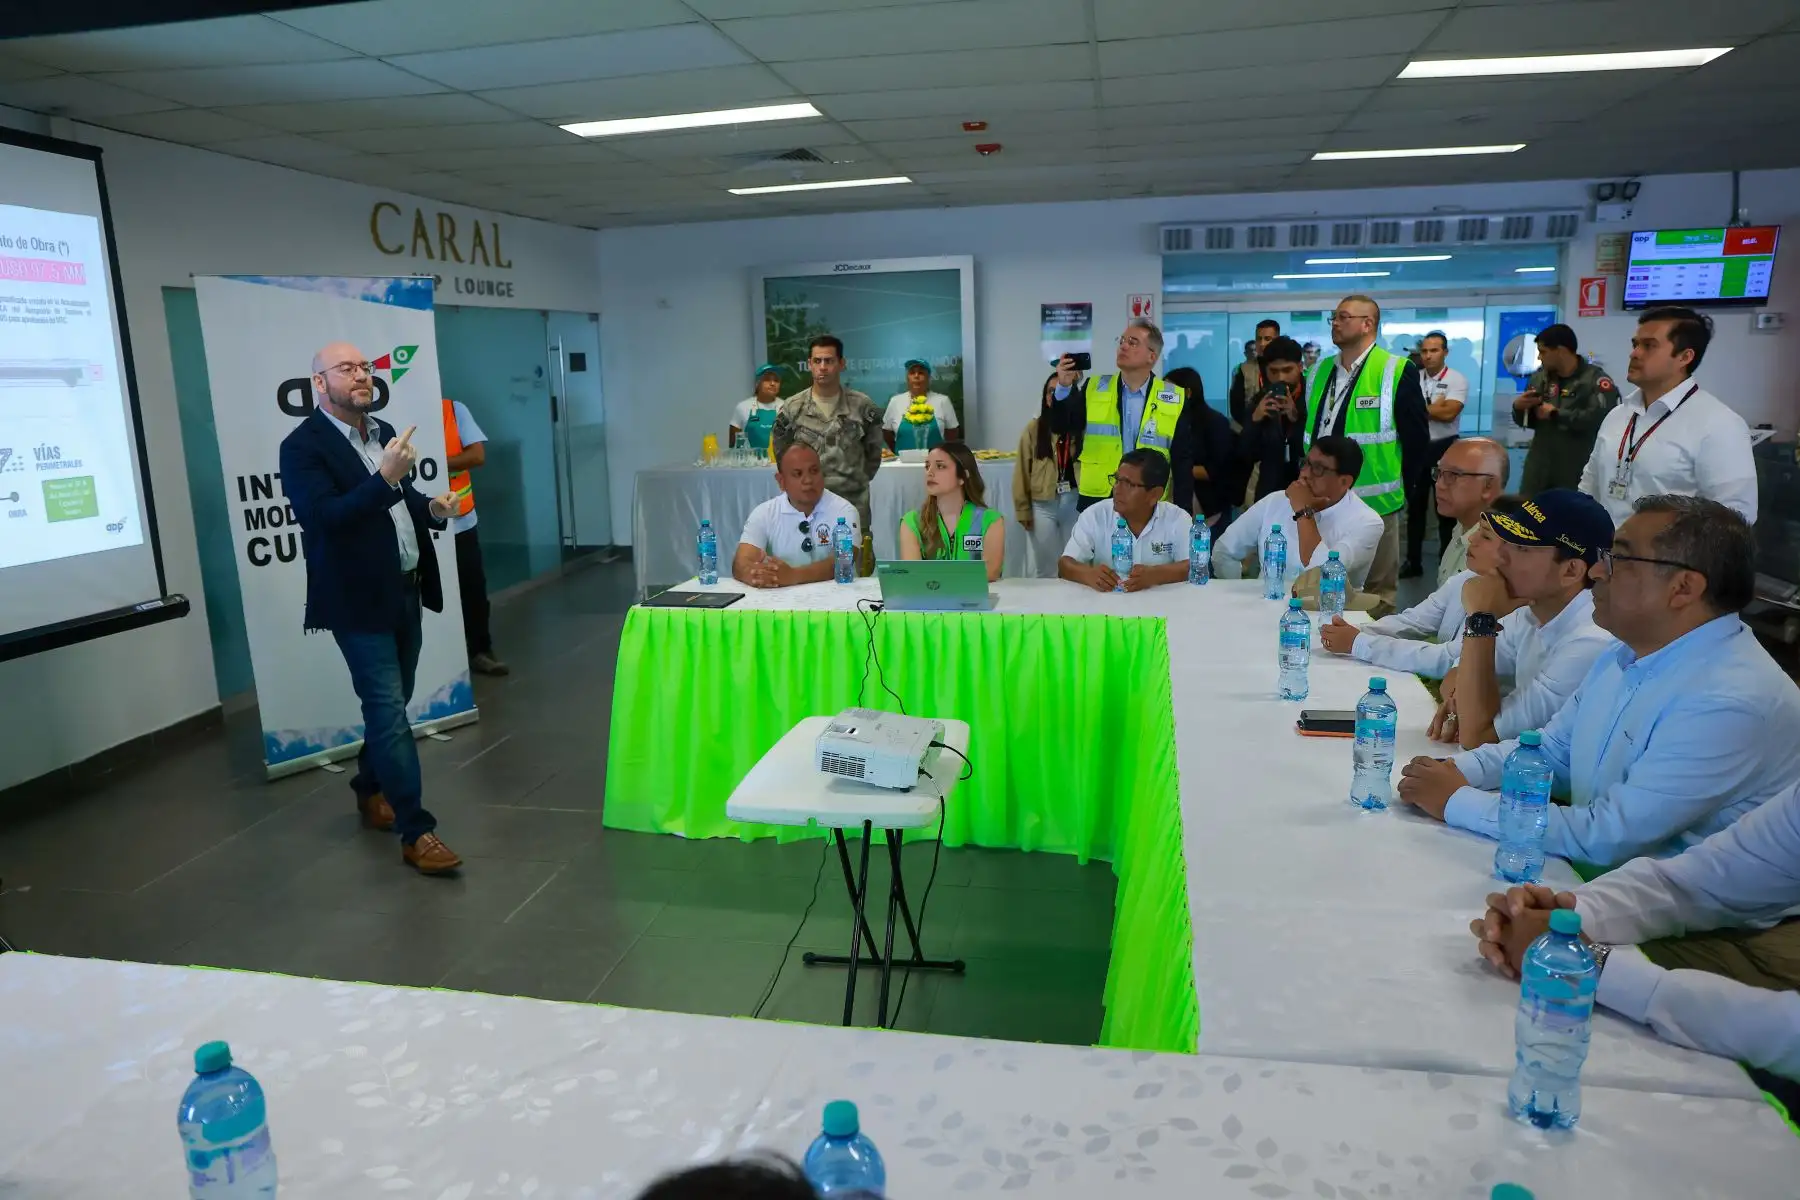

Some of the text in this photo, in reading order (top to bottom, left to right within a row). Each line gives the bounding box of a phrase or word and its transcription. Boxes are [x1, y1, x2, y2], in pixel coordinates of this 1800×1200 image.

[30, 236, 55, 252] Obra
[370, 202, 512, 269] CARAL
[833, 264, 872, 272] JCDecaux
[454, 277, 515, 298] LOUNGE
[33, 443, 61, 461] VÍAS
[36, 459, 83, 471] PERIMETRALES
